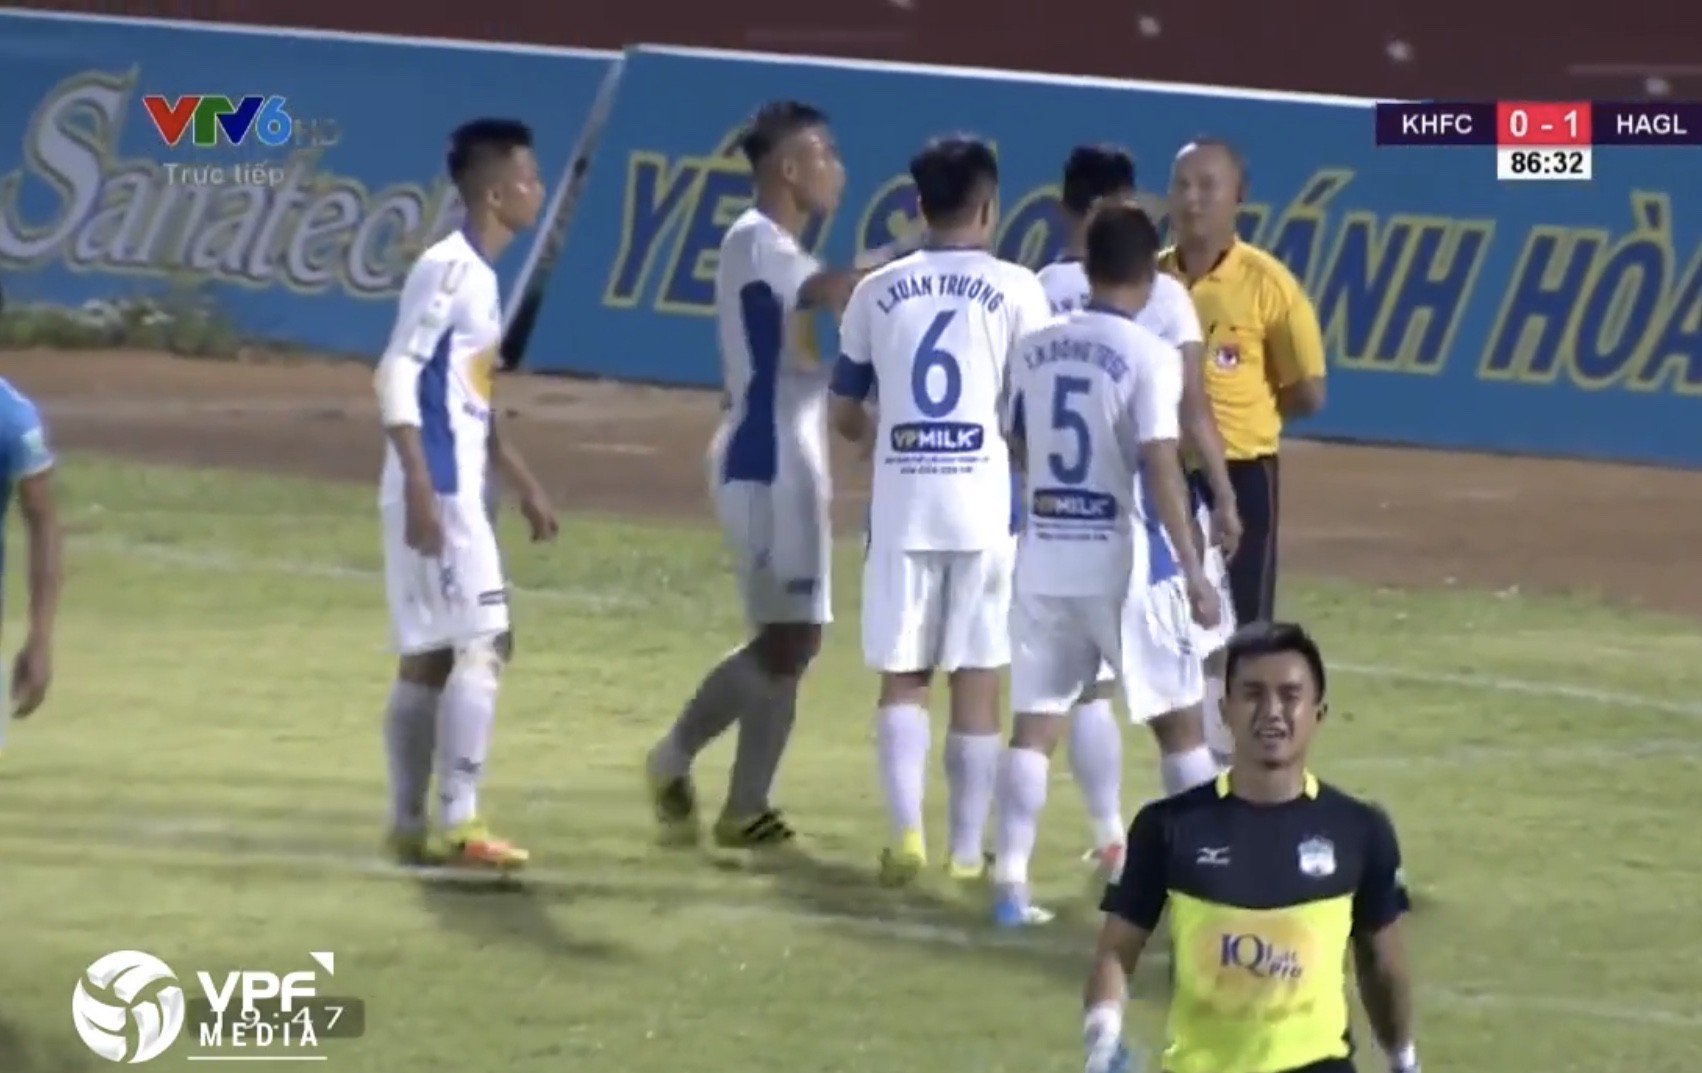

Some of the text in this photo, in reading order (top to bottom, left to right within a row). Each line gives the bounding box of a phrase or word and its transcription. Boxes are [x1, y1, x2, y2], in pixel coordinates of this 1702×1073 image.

[911, 309, 962, 418] 6
[1047, 375, 1092, 484] 5
[1220, 932, 1266, 979] IQ
